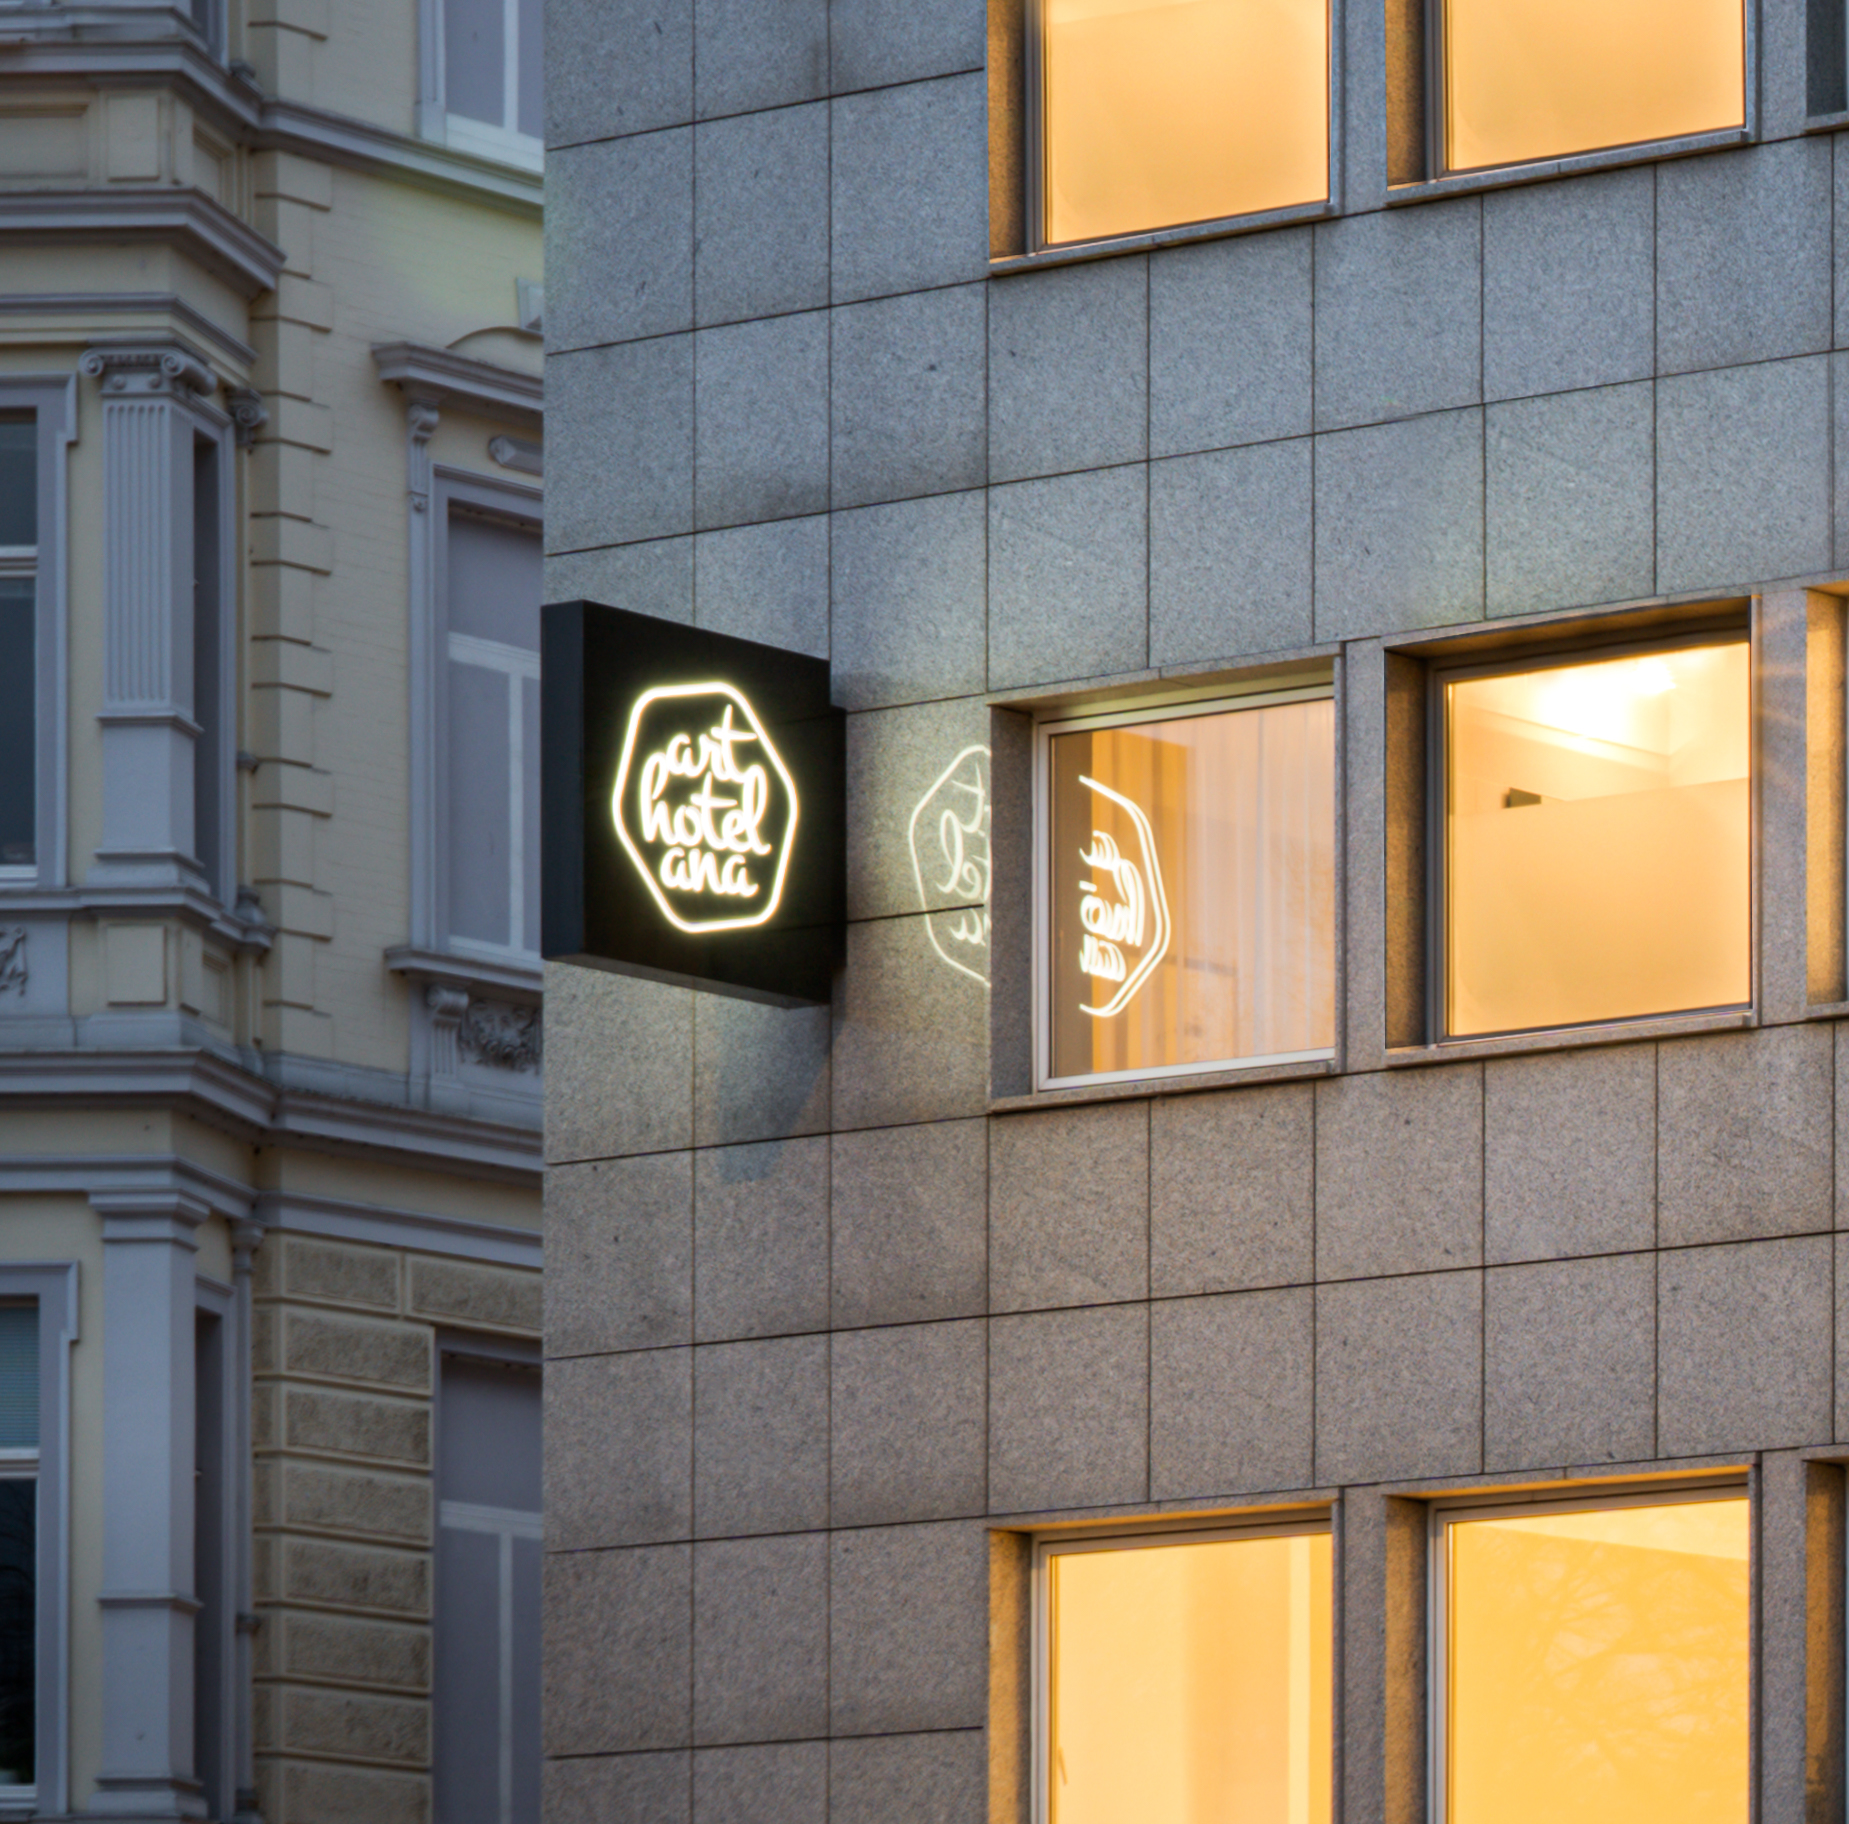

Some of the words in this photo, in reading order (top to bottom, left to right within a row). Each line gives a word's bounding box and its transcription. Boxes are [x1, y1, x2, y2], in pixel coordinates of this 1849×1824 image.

[667, 703, 759, 782] art
[639, 752, 771, 855] hotel
[660, 846, 759, 898] ana
